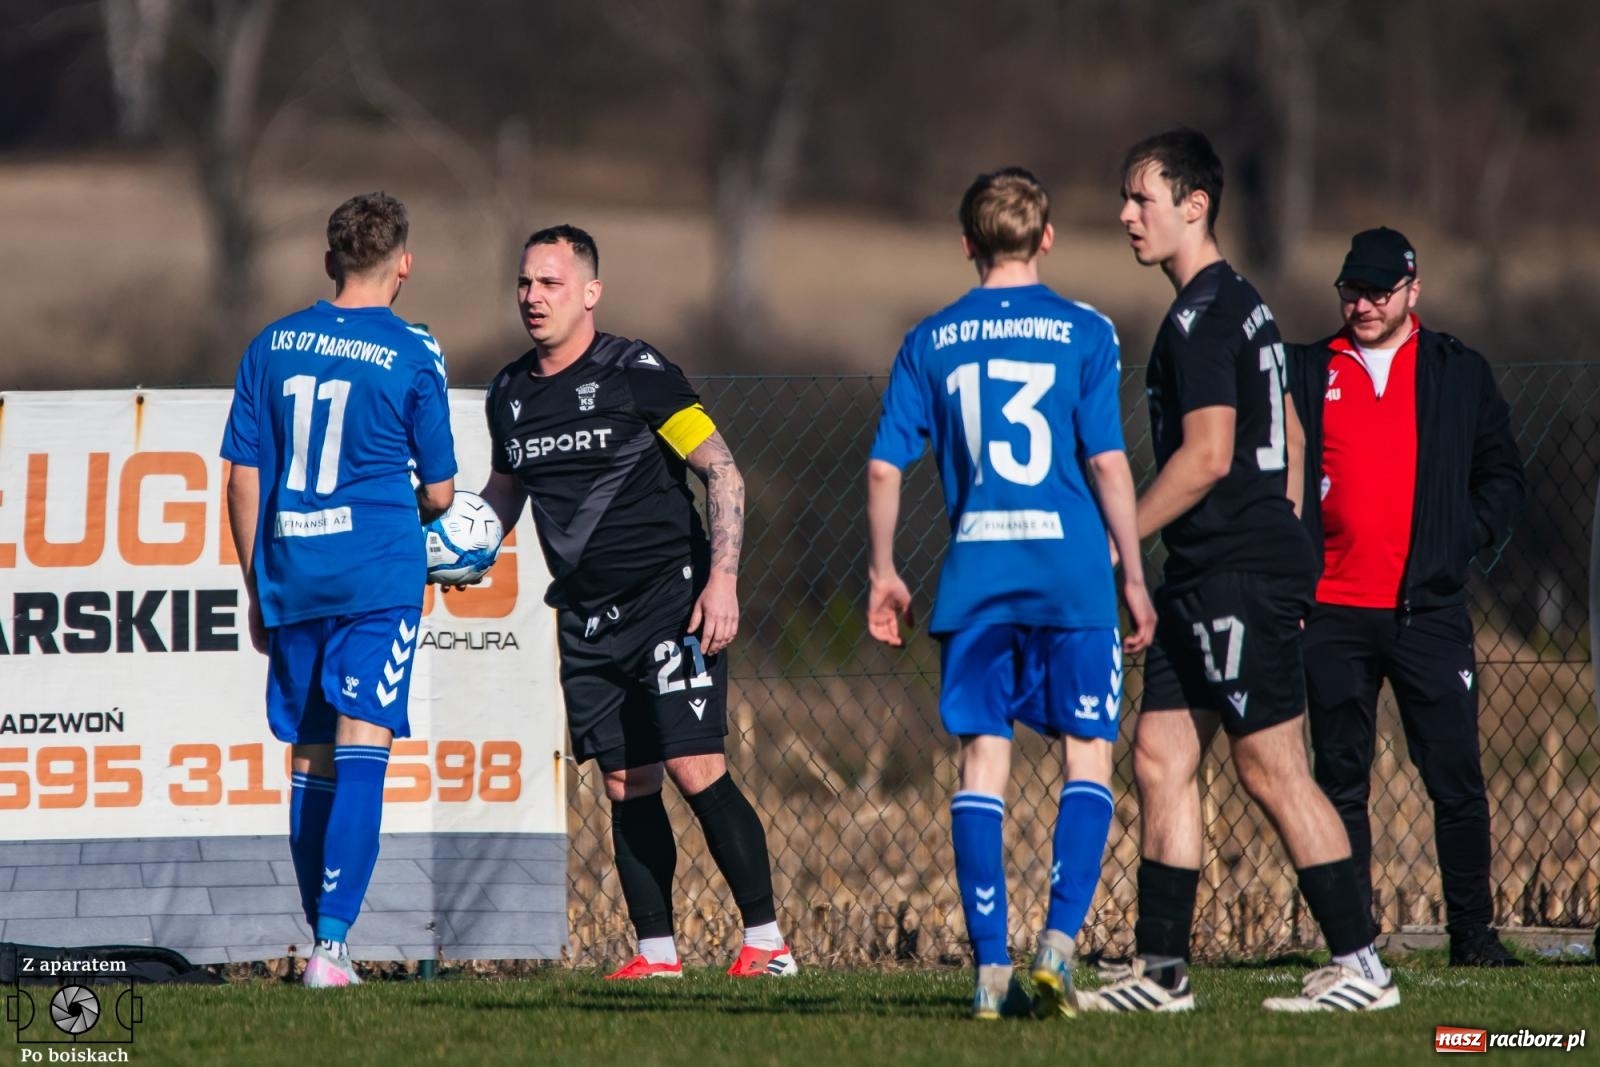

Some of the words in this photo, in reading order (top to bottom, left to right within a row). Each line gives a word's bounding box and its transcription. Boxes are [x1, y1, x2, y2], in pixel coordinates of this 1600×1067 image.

[271, 330, 296, 351] LKS
[296, 331, 317, 352] 07
[314, 333, 398, 370] MARKOWICE
[960, 319, 980, 342] 07
[982, 316, 1074, 344] MARKOWICE
[580, 398, 595, 406] KS
[283, 374, 352, 495] 11
[946, 358, 1056, 487] 13
[525, 428, 613, 459] SPORT
[284, 517, 329, 529] FINANSE
[333, 515, 348, 525] AZ
[0, 588, 239, 656] RSKIE
[419, 631, 519, 651] ACHURA
[654, 635, 713, 695] 21
[1192, 615, 1245, 683] 17
[0, 707, 124, 734] ADZWOŃ
[168, 742, 293, 806] 31
[383, 740, 522, 803] 598
